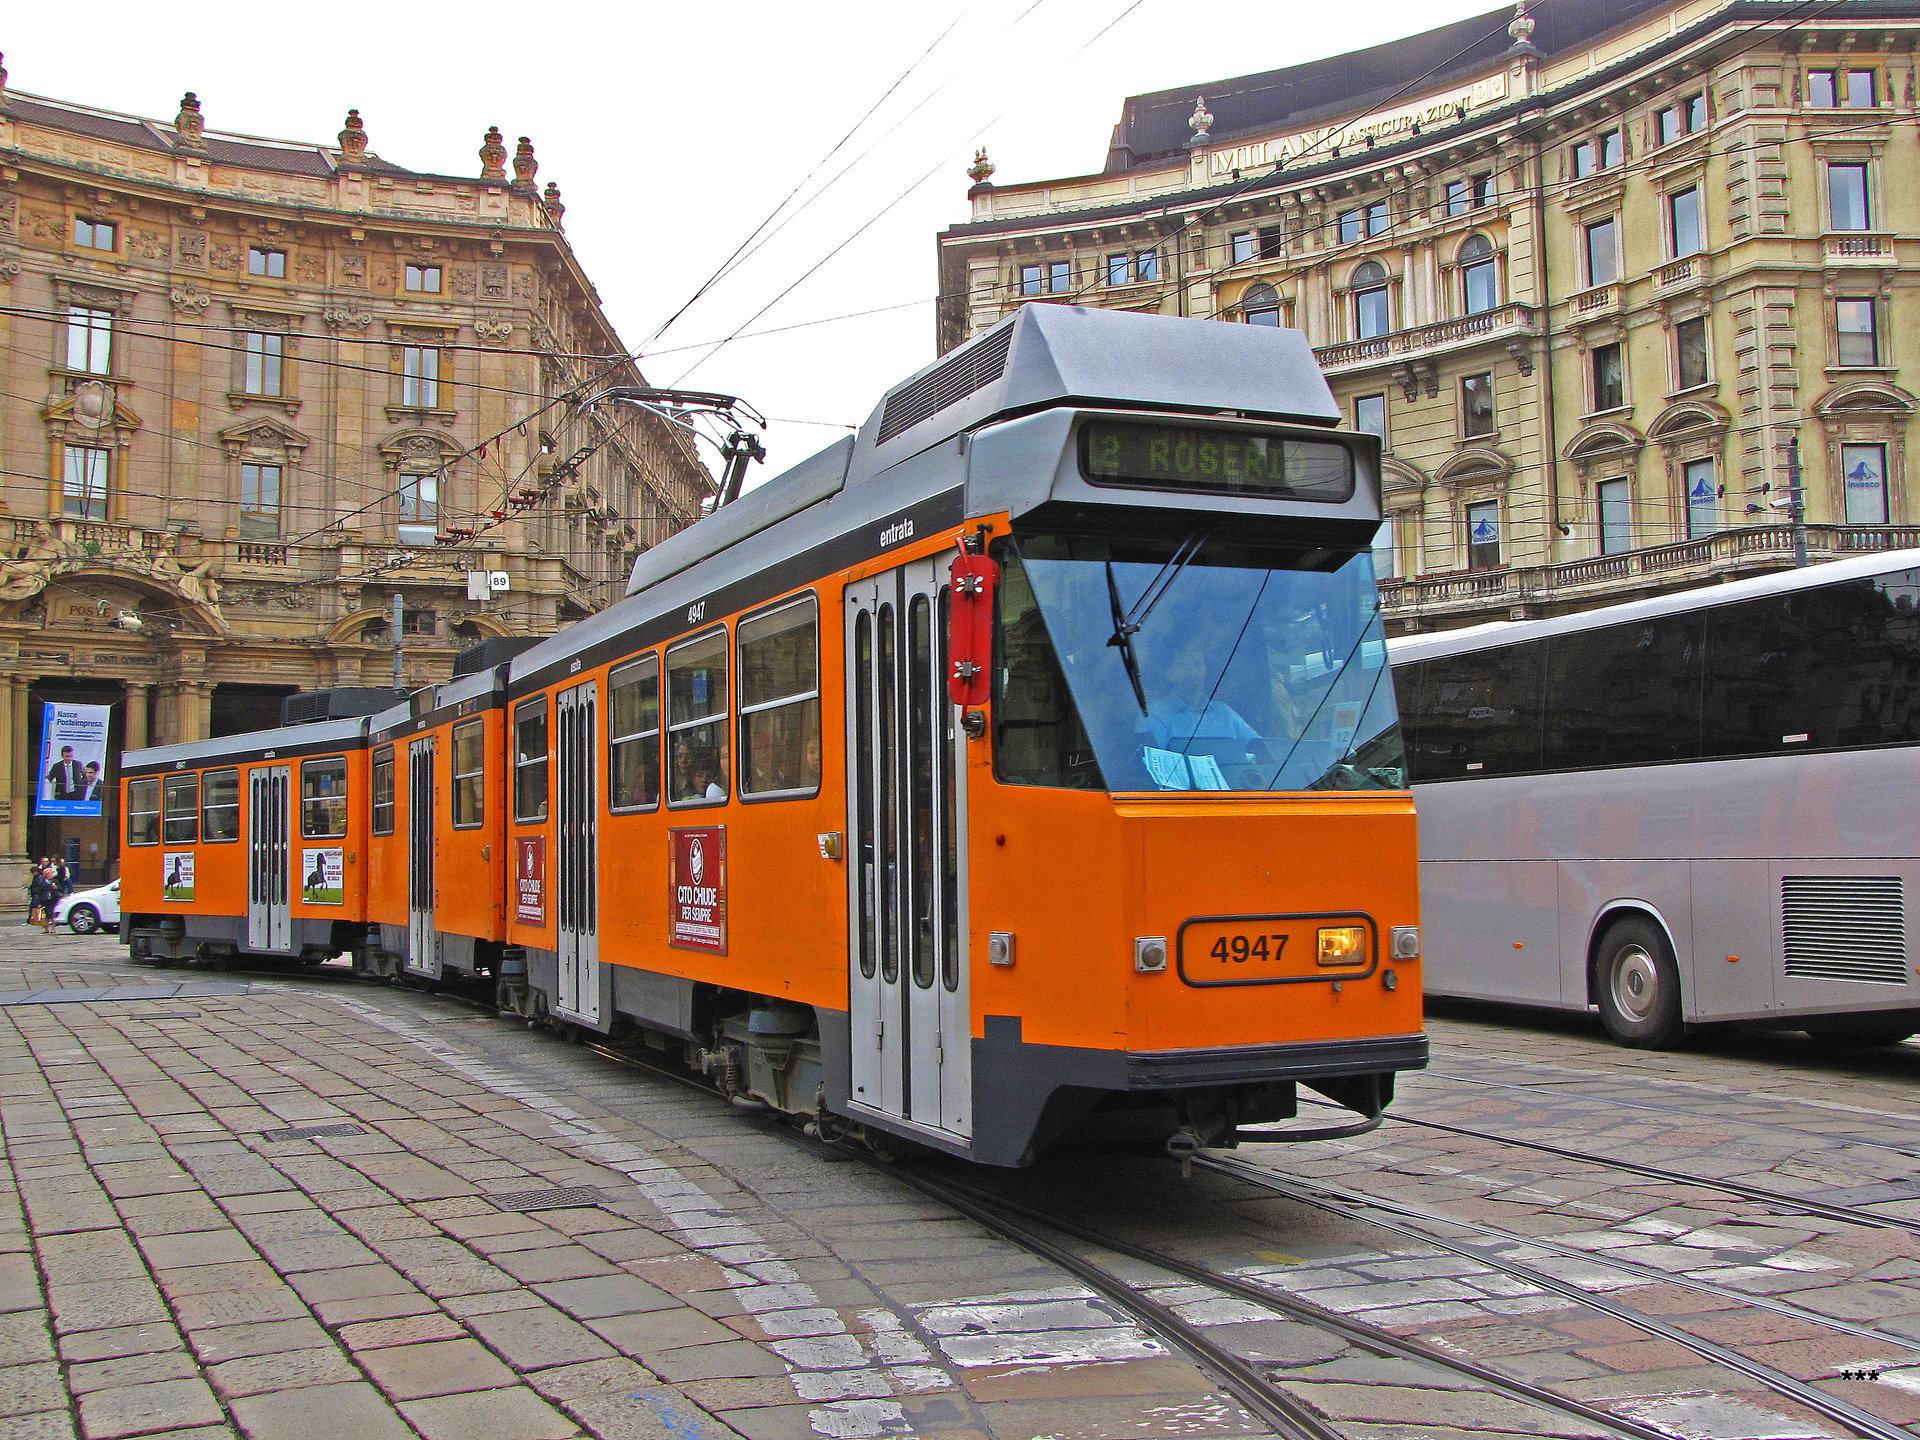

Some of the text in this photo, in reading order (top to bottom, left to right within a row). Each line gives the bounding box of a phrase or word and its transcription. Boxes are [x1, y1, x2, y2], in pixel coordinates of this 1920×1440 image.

[1212, 95, 1471, 175] MILANO ASSICURAZIONI
[1149, 437, 1304, 480] ROSERI
[880, 517, 914, 548] entrata
[493, 577, 507, 586] 89
[687, 600, 706, 625] 4947
[57, 710, 79, 719] Nasce
[677, 885, 718, 907] CITO CHIUDE
[682, 906, 712, 923] PER SEMPRE
[1210, 934, 1290, 964] 4947
